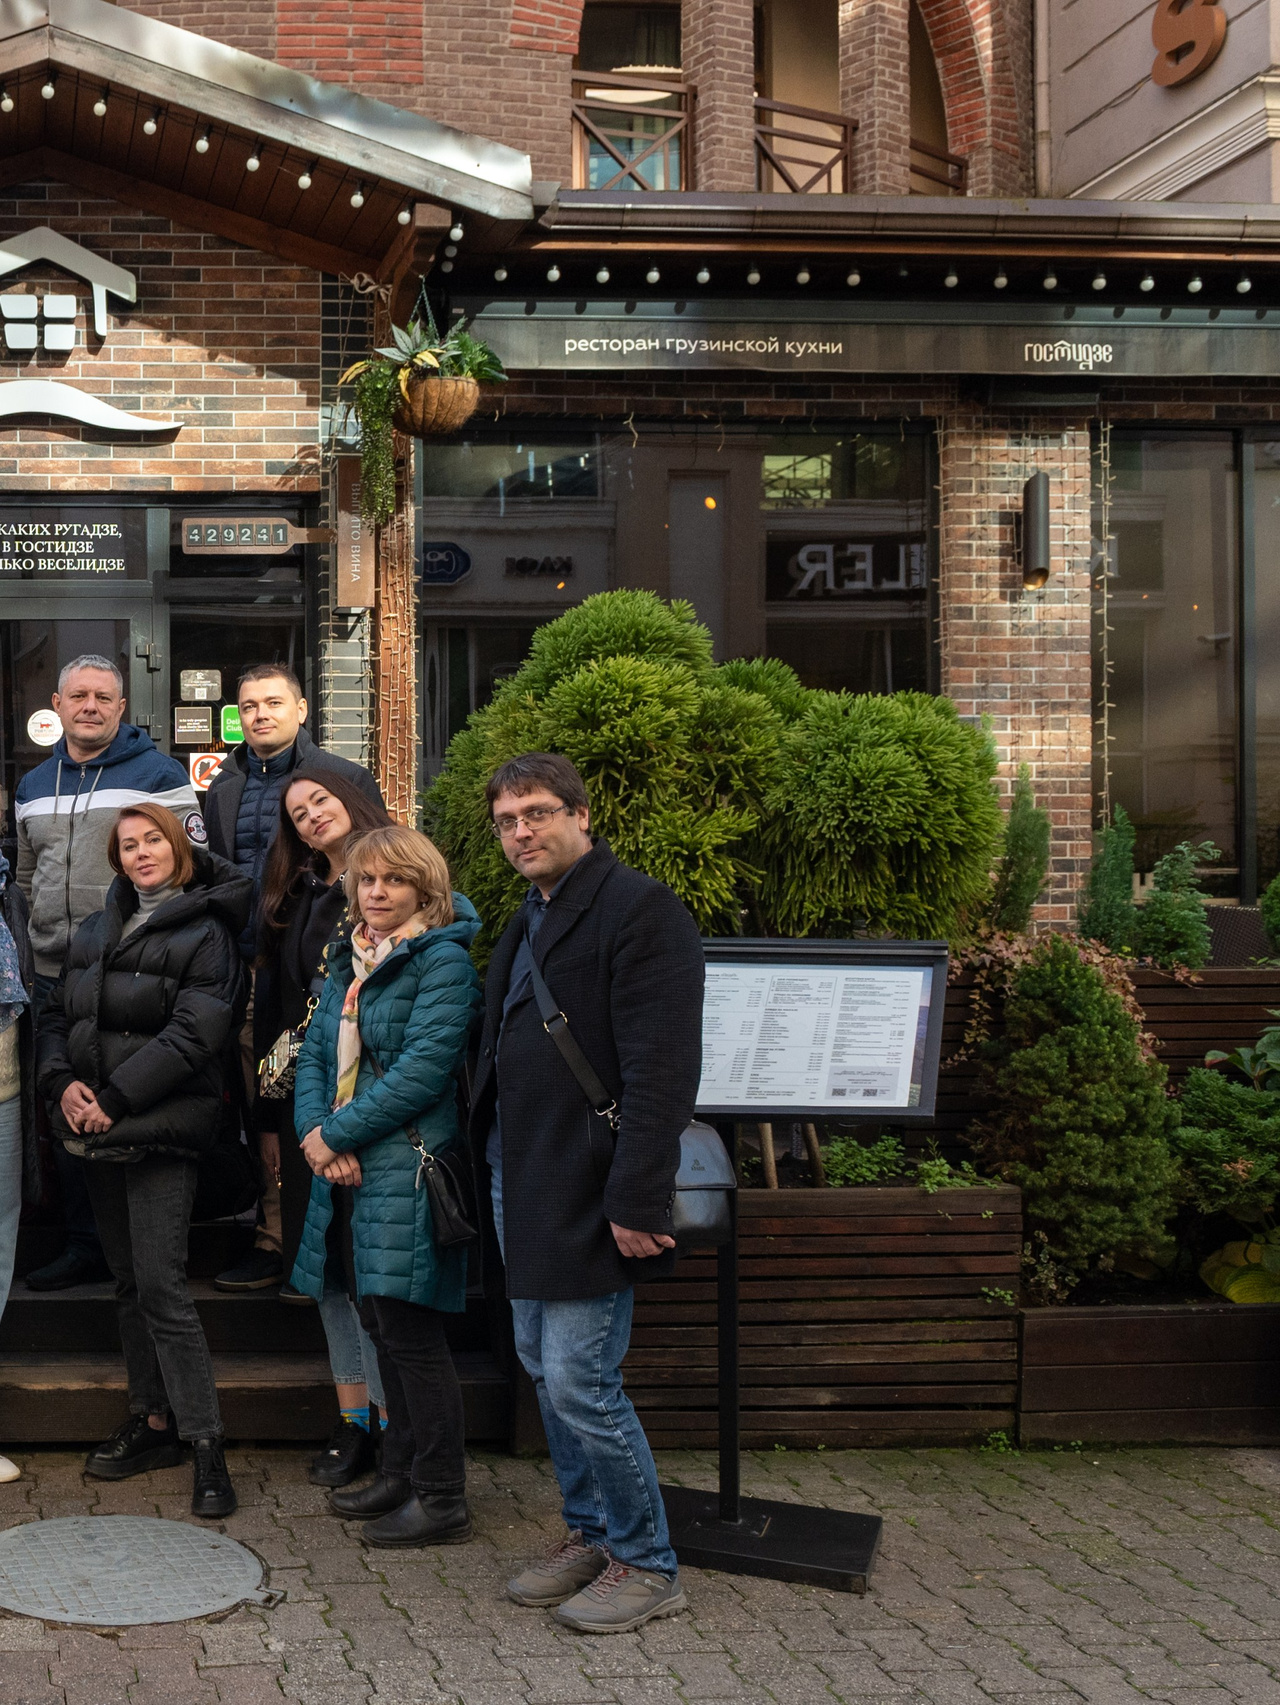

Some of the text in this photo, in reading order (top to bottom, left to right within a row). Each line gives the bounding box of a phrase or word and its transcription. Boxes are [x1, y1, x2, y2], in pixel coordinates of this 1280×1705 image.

[564, 337, 843, 357] ресторан грузинской кухни
[54, 523, 123, 539] РУГАДЗЕ,
[2, 541, 95, 556] В ГОСТИДЗЕ
[38, 558, 126, 573] ВЕСЕЛИДЗЕ
[350, 545, 361, 583] ВИНА
